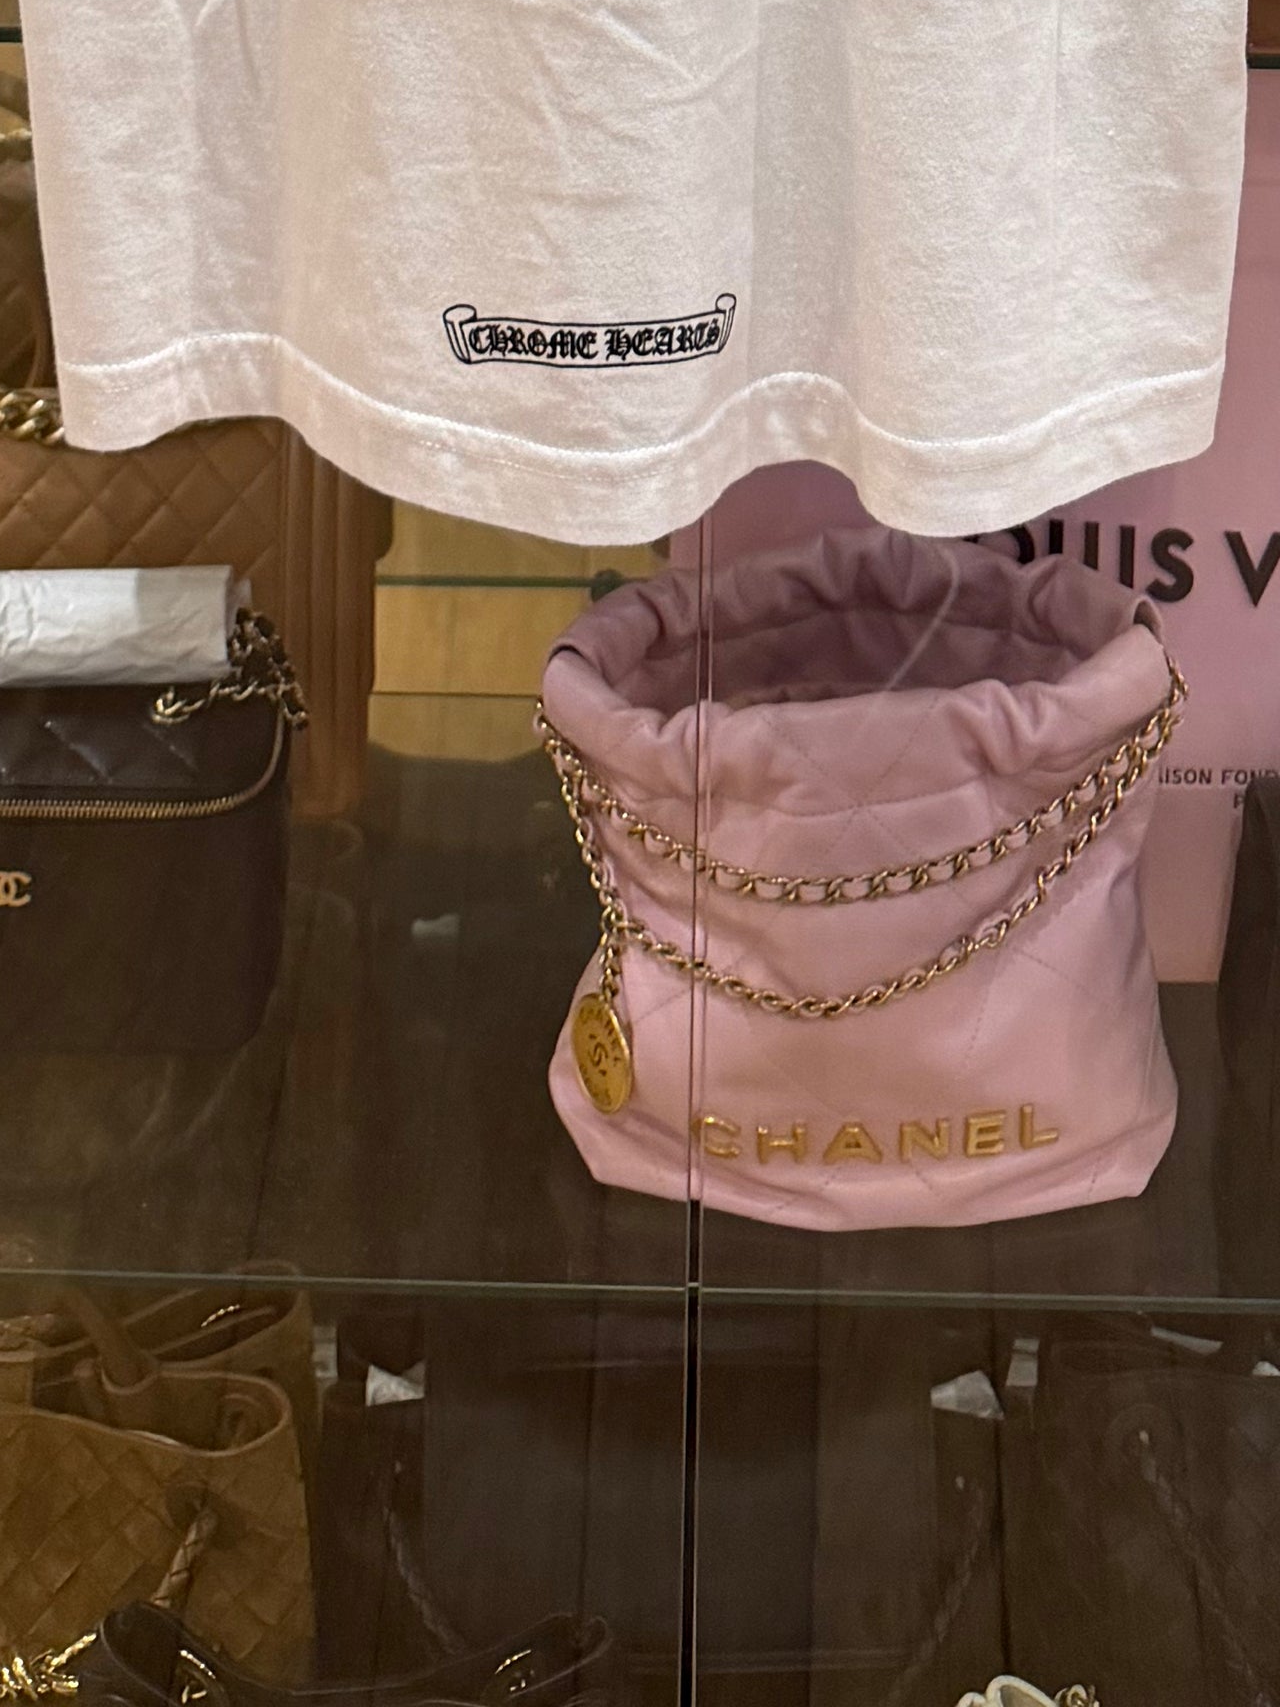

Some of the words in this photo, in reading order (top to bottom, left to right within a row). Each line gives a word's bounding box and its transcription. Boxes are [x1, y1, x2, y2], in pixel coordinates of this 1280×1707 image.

[468, 324, 597, 360] CHROME
[605, 317, 721, 361] HEARTS
[691, 1103, 1060, 1165] CHANEL
